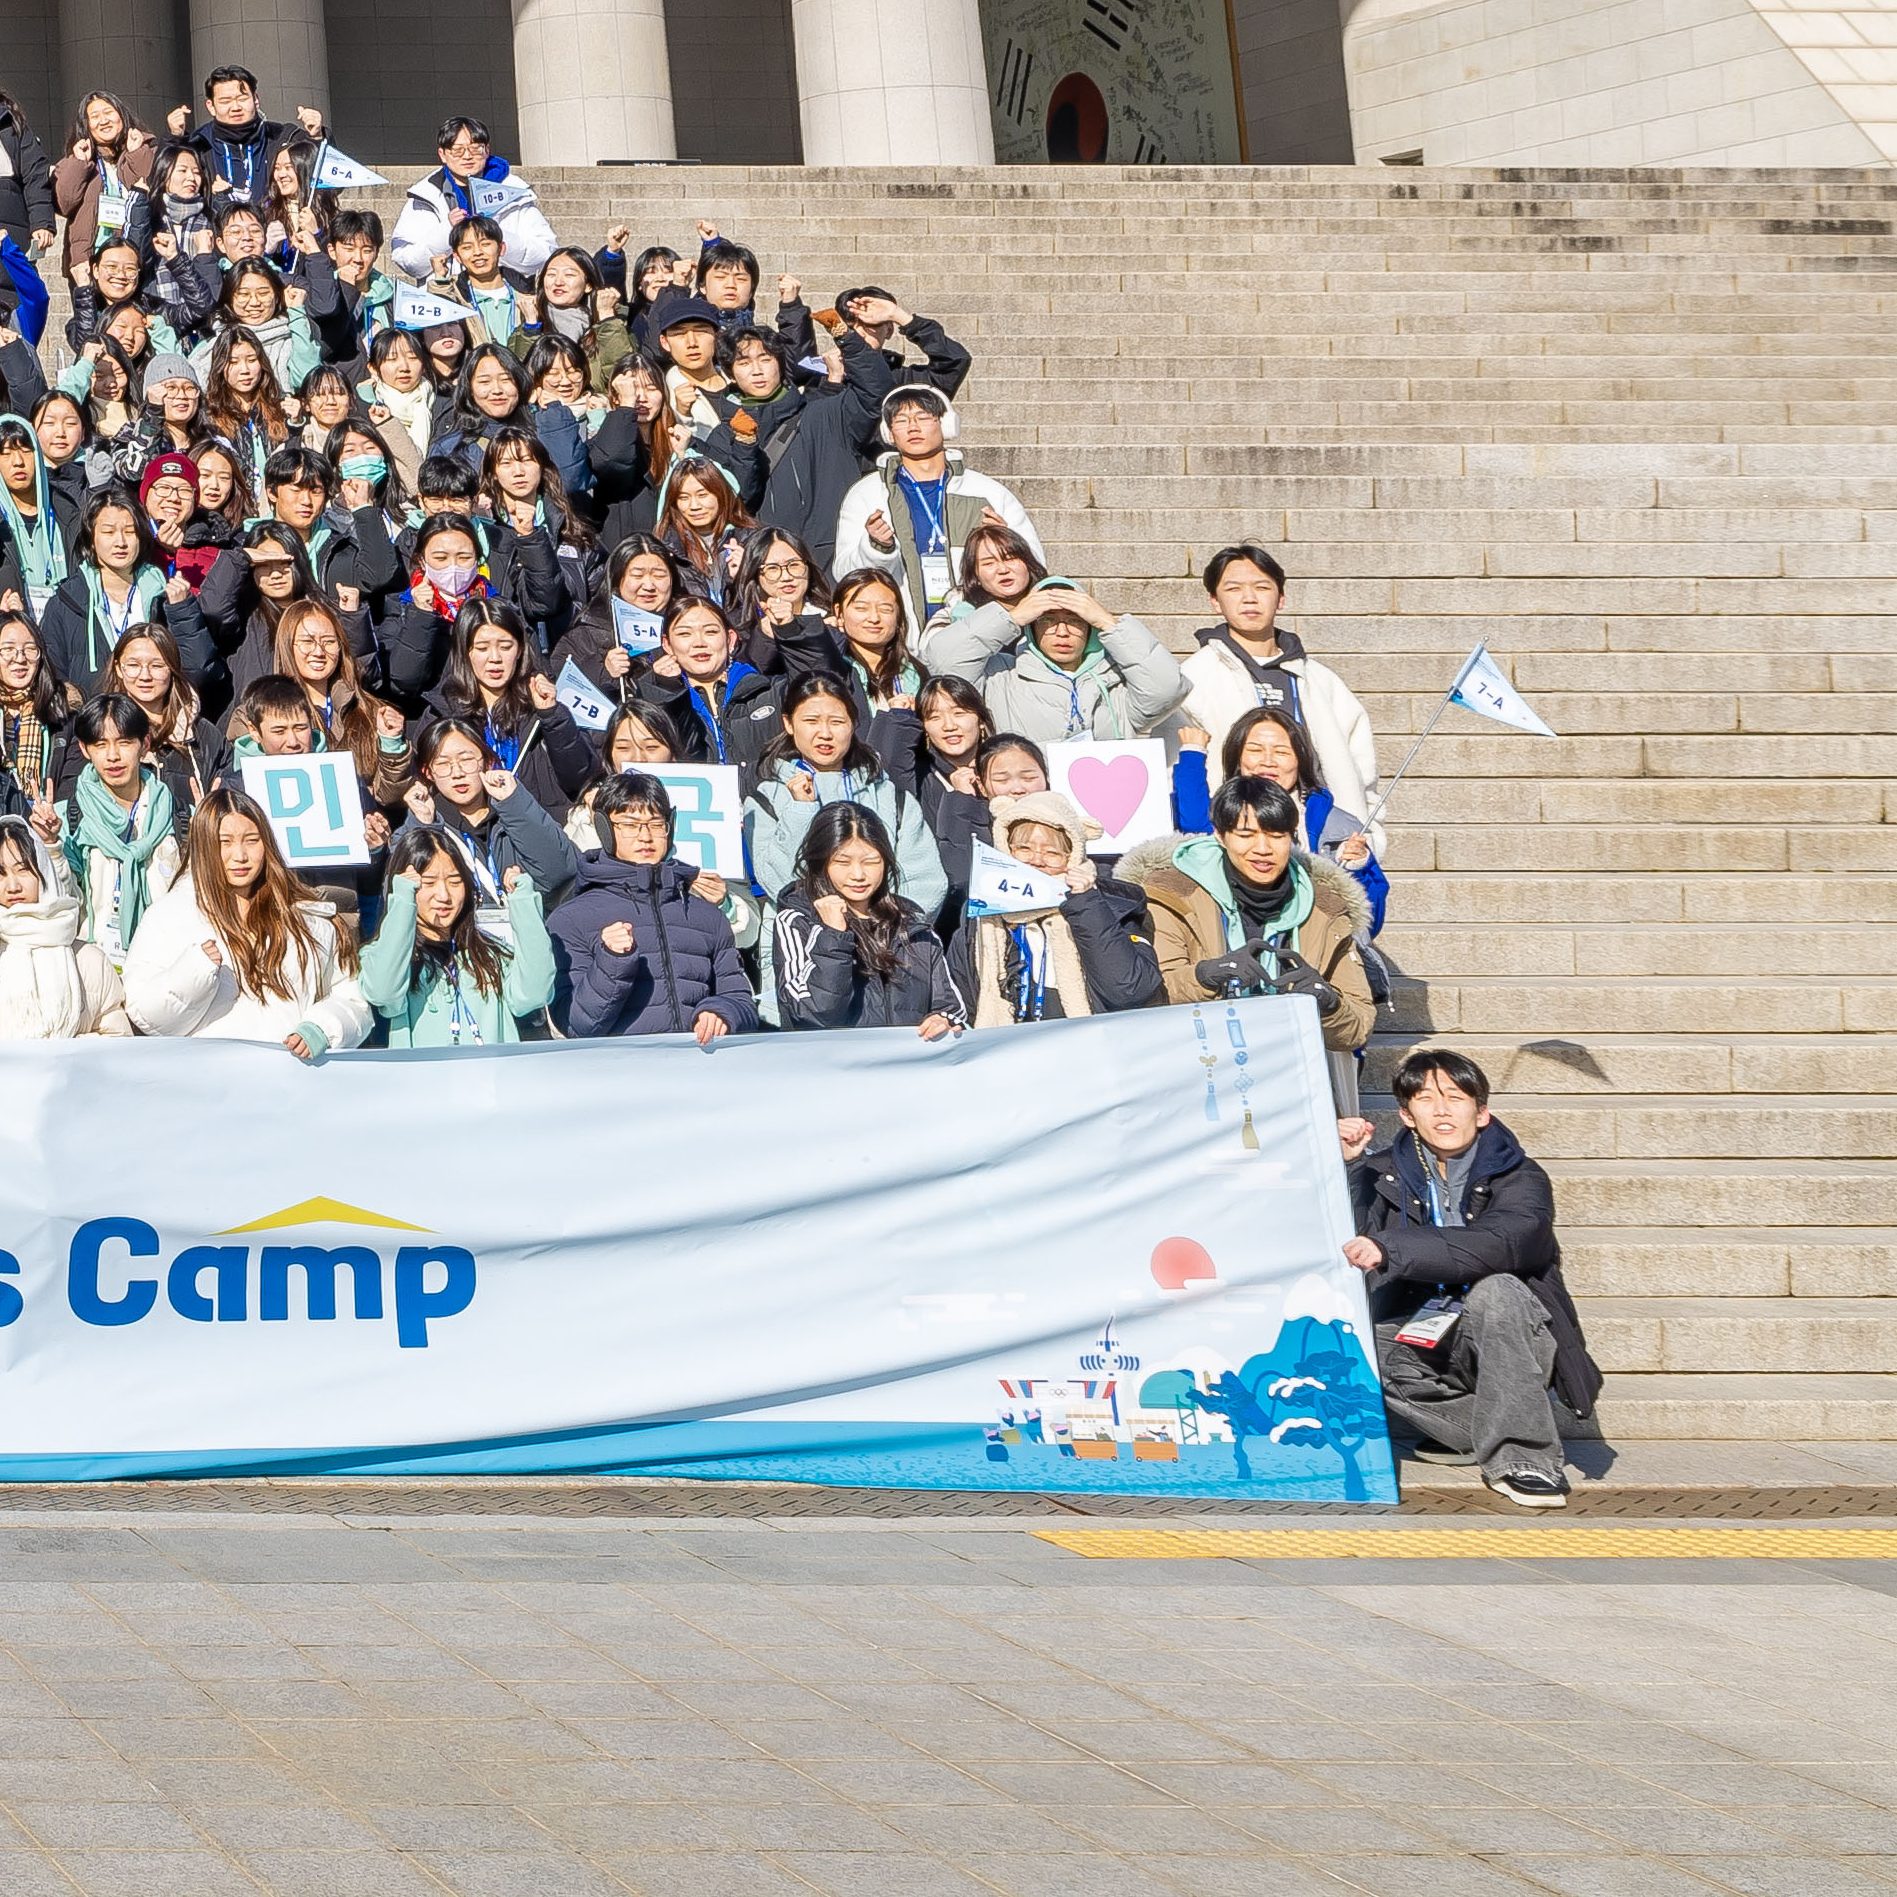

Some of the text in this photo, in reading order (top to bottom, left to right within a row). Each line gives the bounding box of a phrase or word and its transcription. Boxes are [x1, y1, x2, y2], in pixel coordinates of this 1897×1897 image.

[331, 166, 352, 179] 6-A
[484, 192, 504, 204] 10-B
[411, 305, 441, 317] 12-B
[633, 624, 658, 638] 5-A
[1478, 682, 1503, 710] 7-A
[572, 695, 599, 718] 7-B
[265, 763, 351, 858] 민
[998, 879, 1034, 898] 4-A
[68, 1215, 478, 1349] Camp
